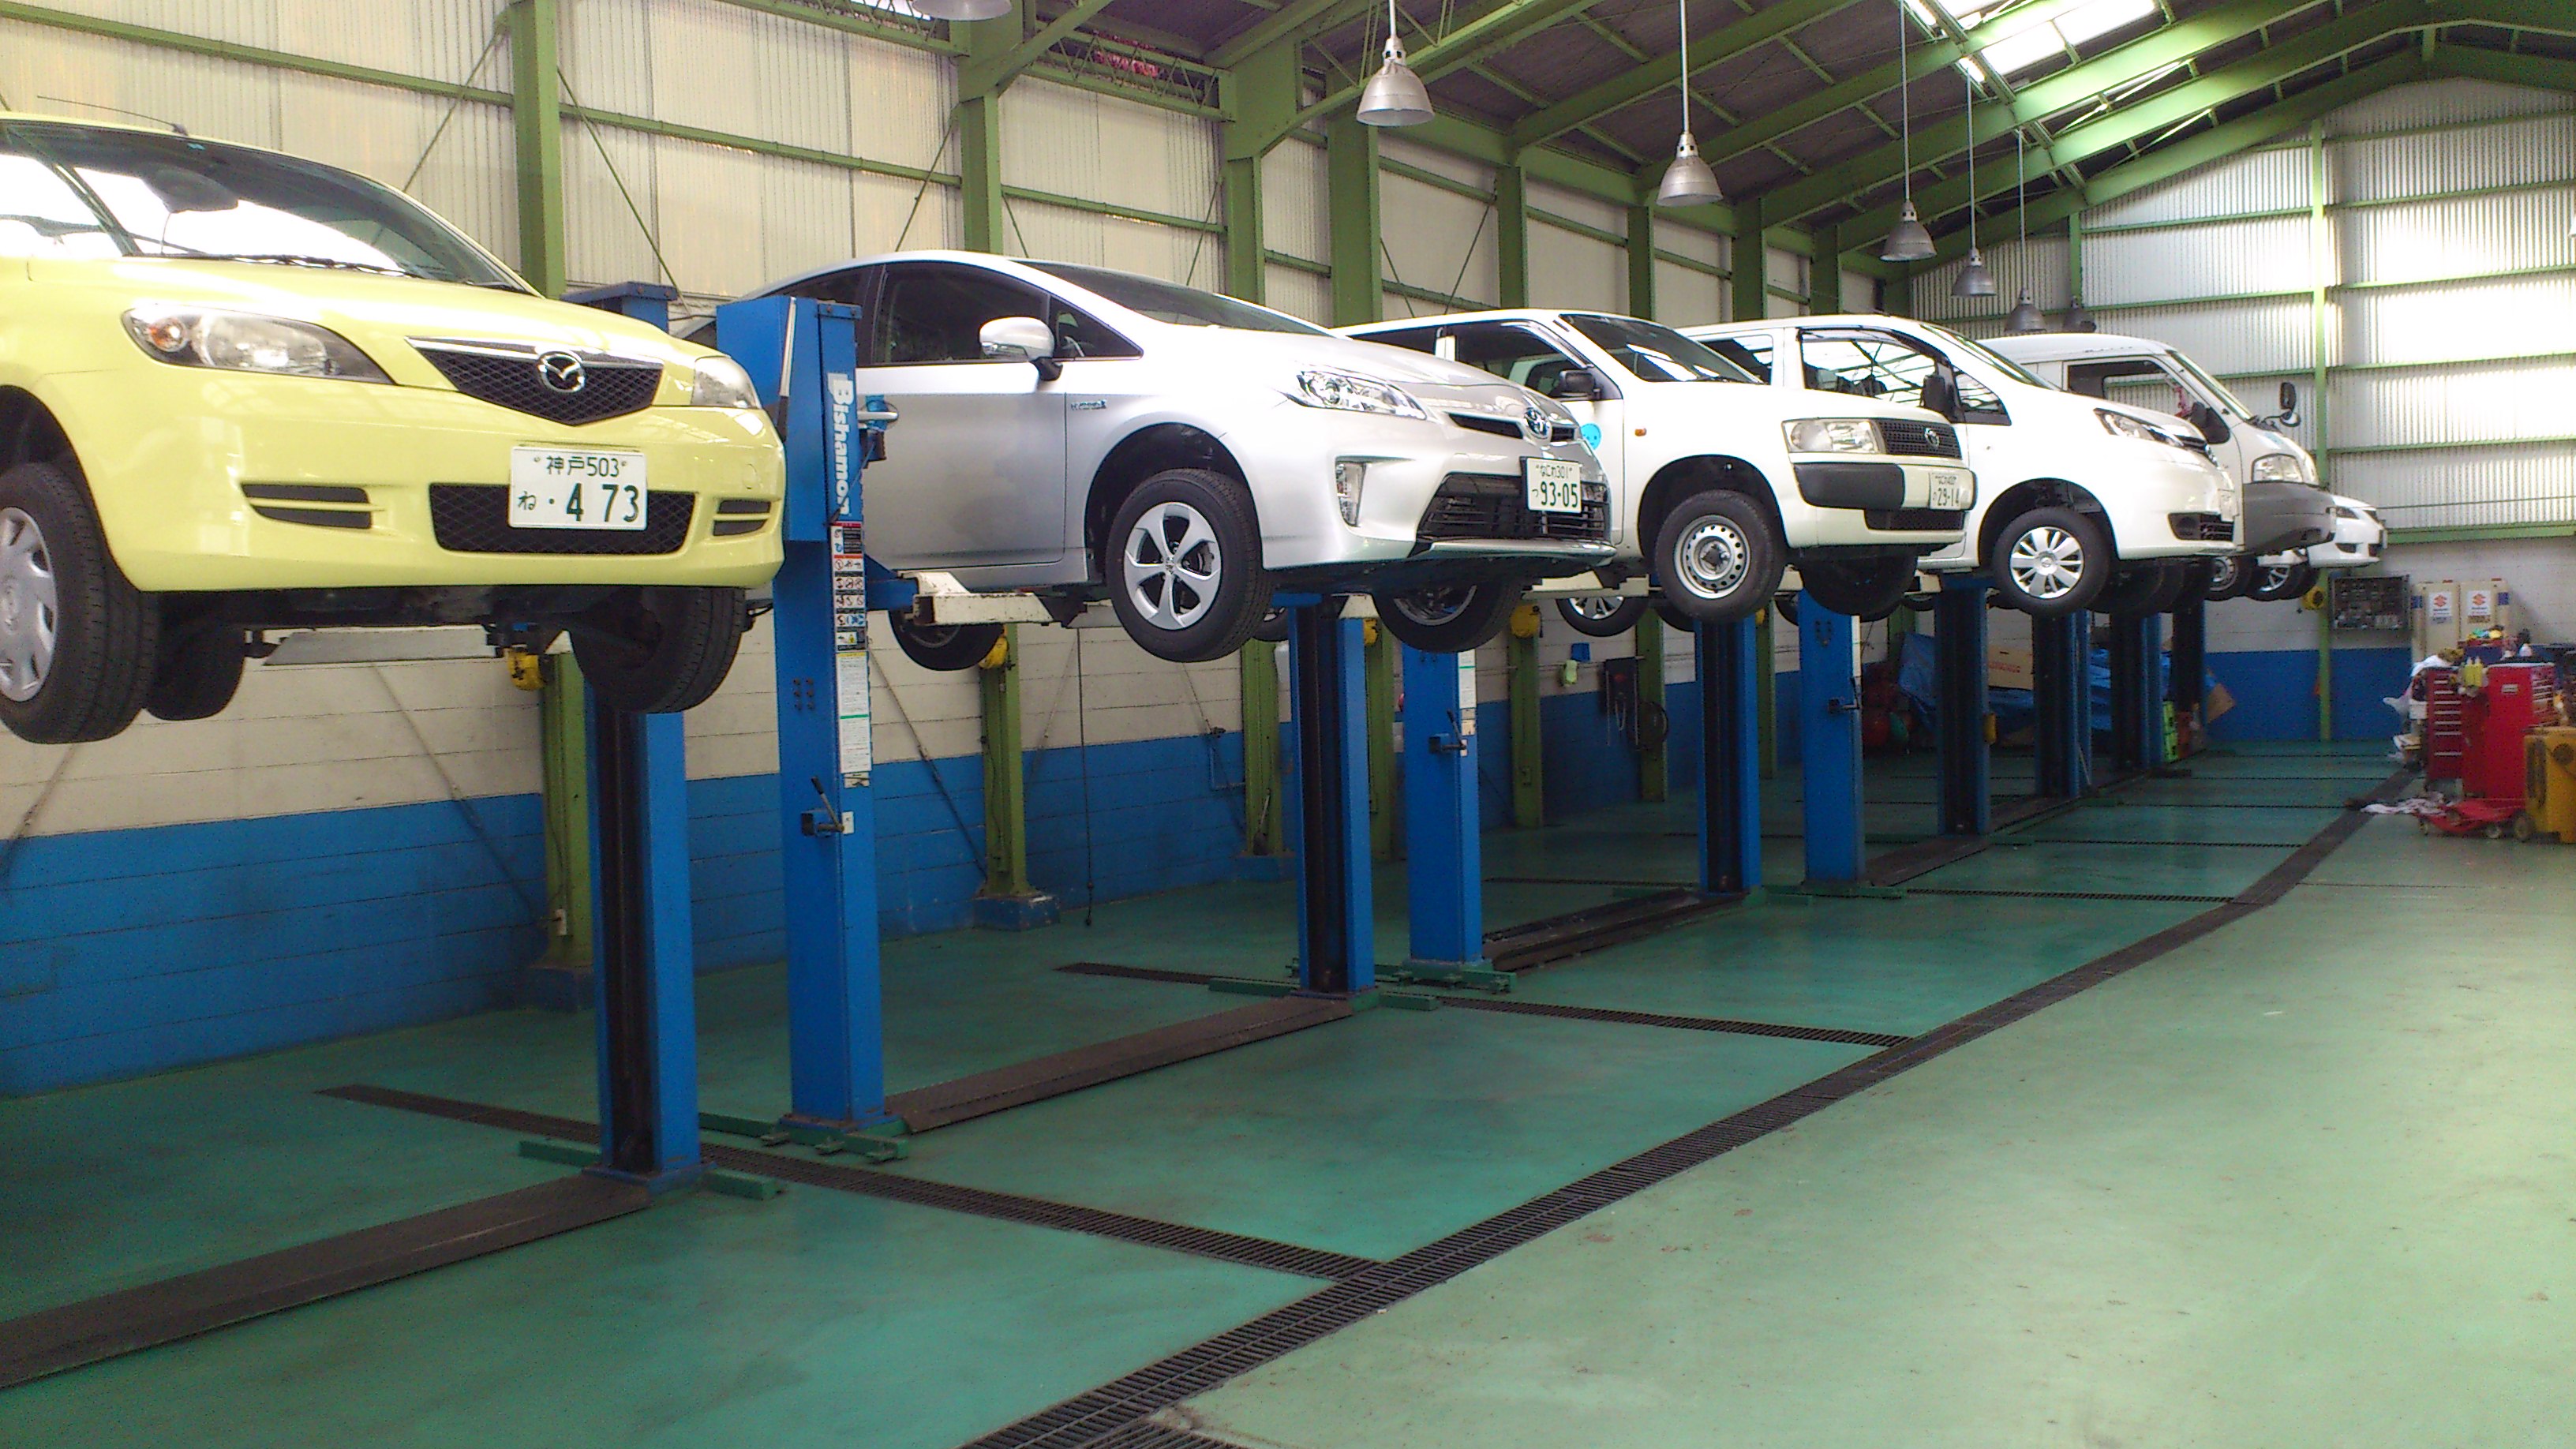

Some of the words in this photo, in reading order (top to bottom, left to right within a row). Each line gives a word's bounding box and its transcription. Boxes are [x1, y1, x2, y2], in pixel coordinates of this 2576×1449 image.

[833, 379, 855, 516] Bishamon
[546, 456, 620, 477] 神戸503
[518, 491, 537, 511] ね
[1540, 481, 1578, 507] 93-05
